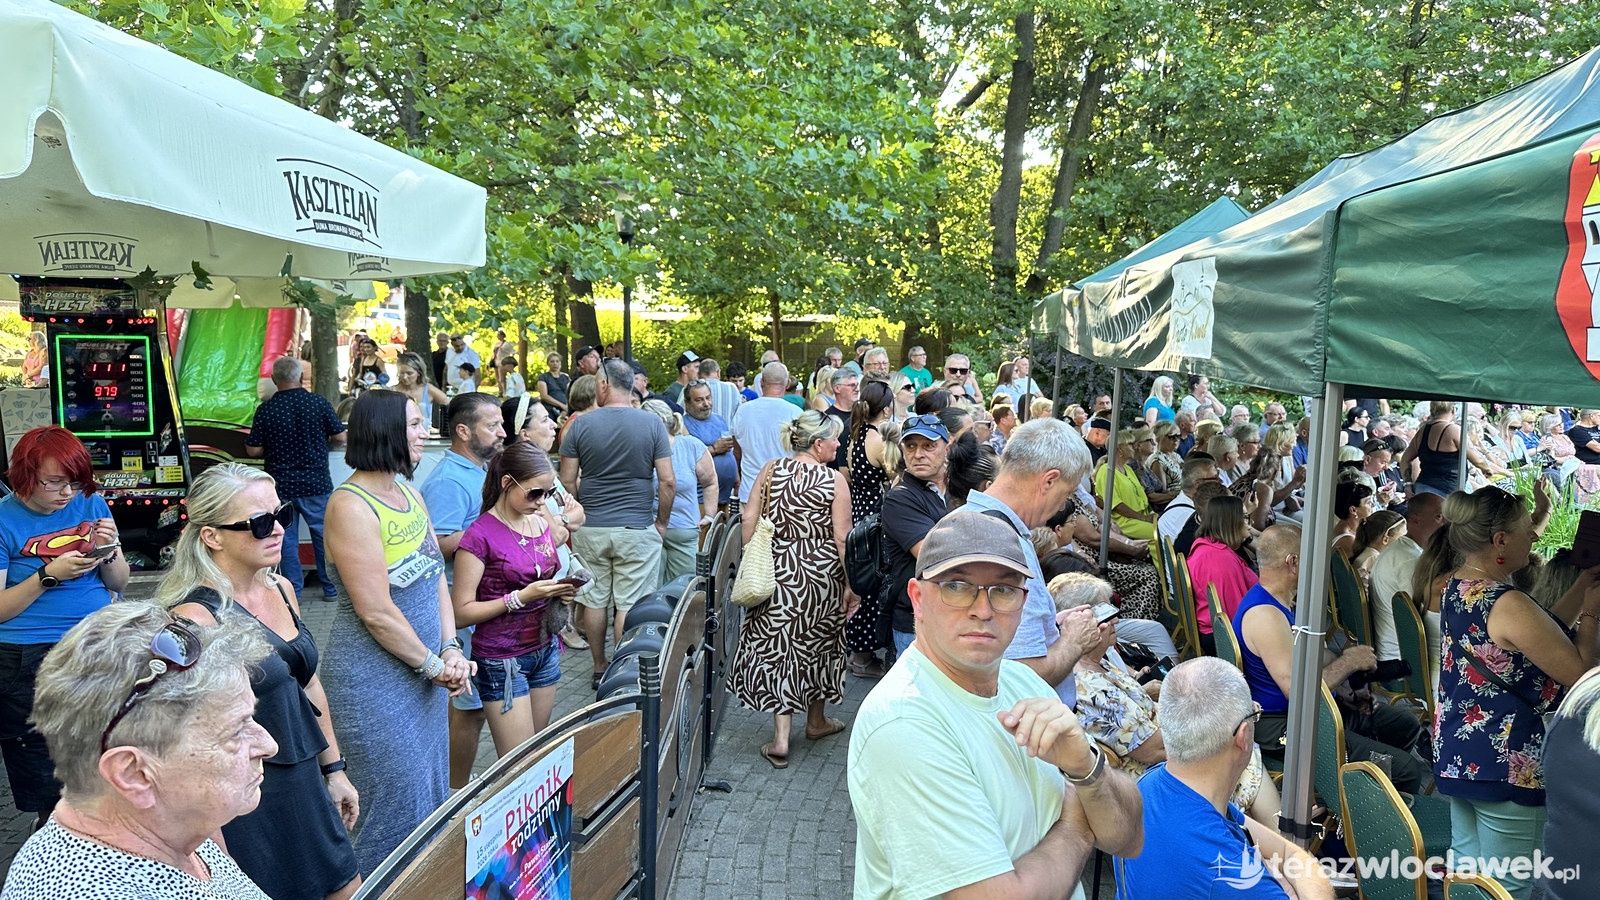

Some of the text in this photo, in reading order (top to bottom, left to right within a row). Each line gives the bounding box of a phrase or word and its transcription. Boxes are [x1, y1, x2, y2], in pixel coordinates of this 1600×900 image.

[283, 171, 379, 238] KASZTELAN
[45, 291, 90, 300] DOUBLE
[44, 300, 90, 311] HIT
[95, 386, 118, 396] 979
[104, 478, 136, 487] HIT
[397, 567, 417, 583] JPN
[505, 765, 564, 839] Piknik
[511, 791, 562, 855] rodzinny
